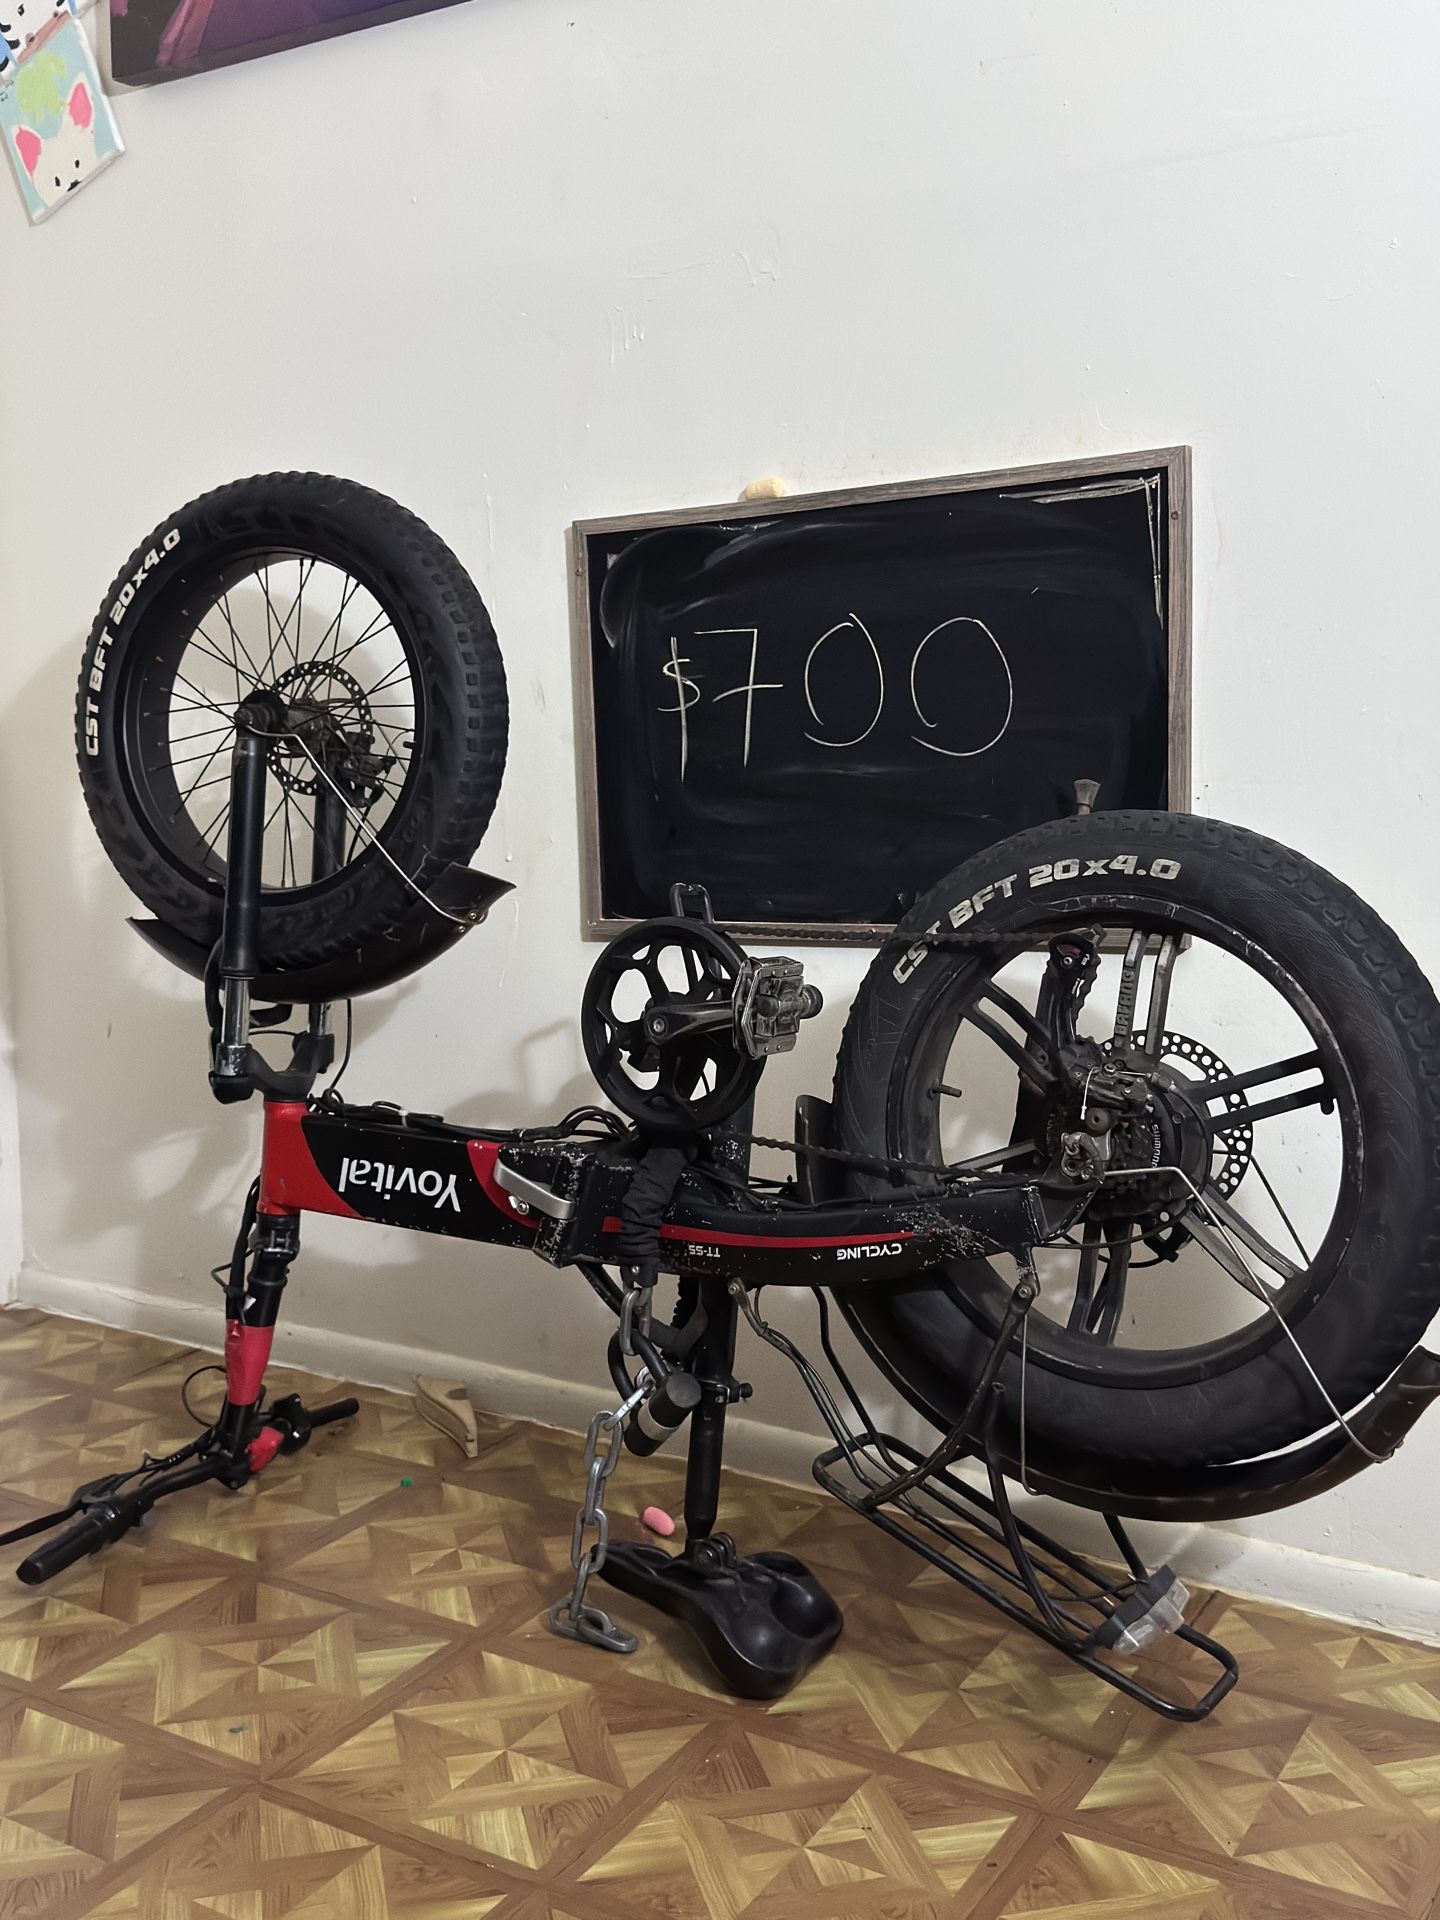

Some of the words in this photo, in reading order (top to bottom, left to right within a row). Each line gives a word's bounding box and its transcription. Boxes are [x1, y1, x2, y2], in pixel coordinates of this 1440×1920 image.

[109, 528, 181, 626] 20x4.0
[88, 625, 114, 692] BFT
[85, 696, 100, 757] CST
[657, 613, 1013, 783] $700
[948, 873, 1018, 929] BFT
[1028, 854, 1181, 888] 20x4.0
[338, 1157, 462, 1213] Yovital
[836, 1242, 903, 1261] CYCLING
